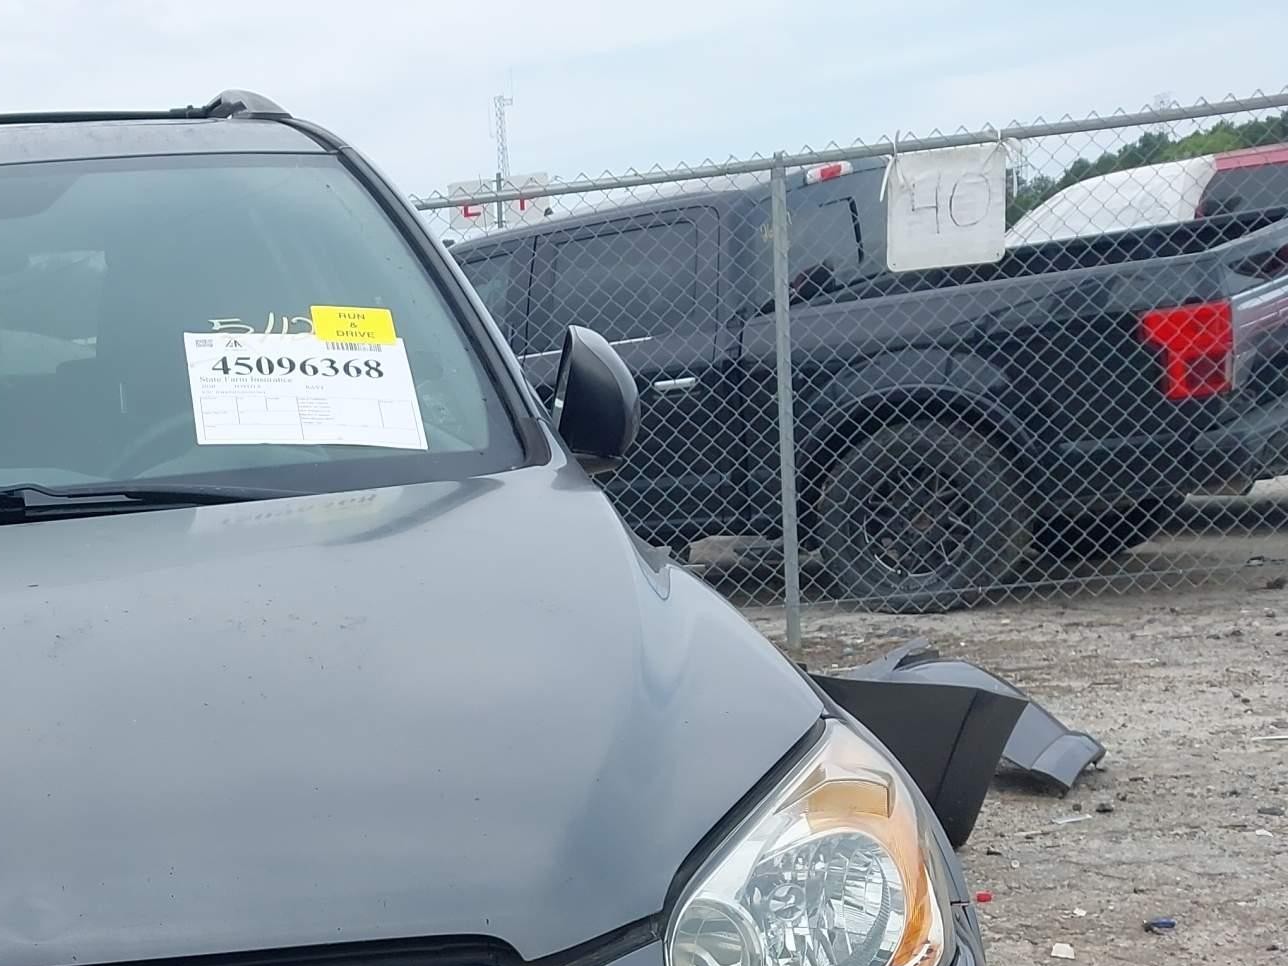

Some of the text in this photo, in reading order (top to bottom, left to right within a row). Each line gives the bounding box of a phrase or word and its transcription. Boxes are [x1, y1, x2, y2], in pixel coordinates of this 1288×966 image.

[338, 312, 366, 320] RUN
[335, 330, 376, 339] DRIVE
[211, 355, 384, 379] 45096368
